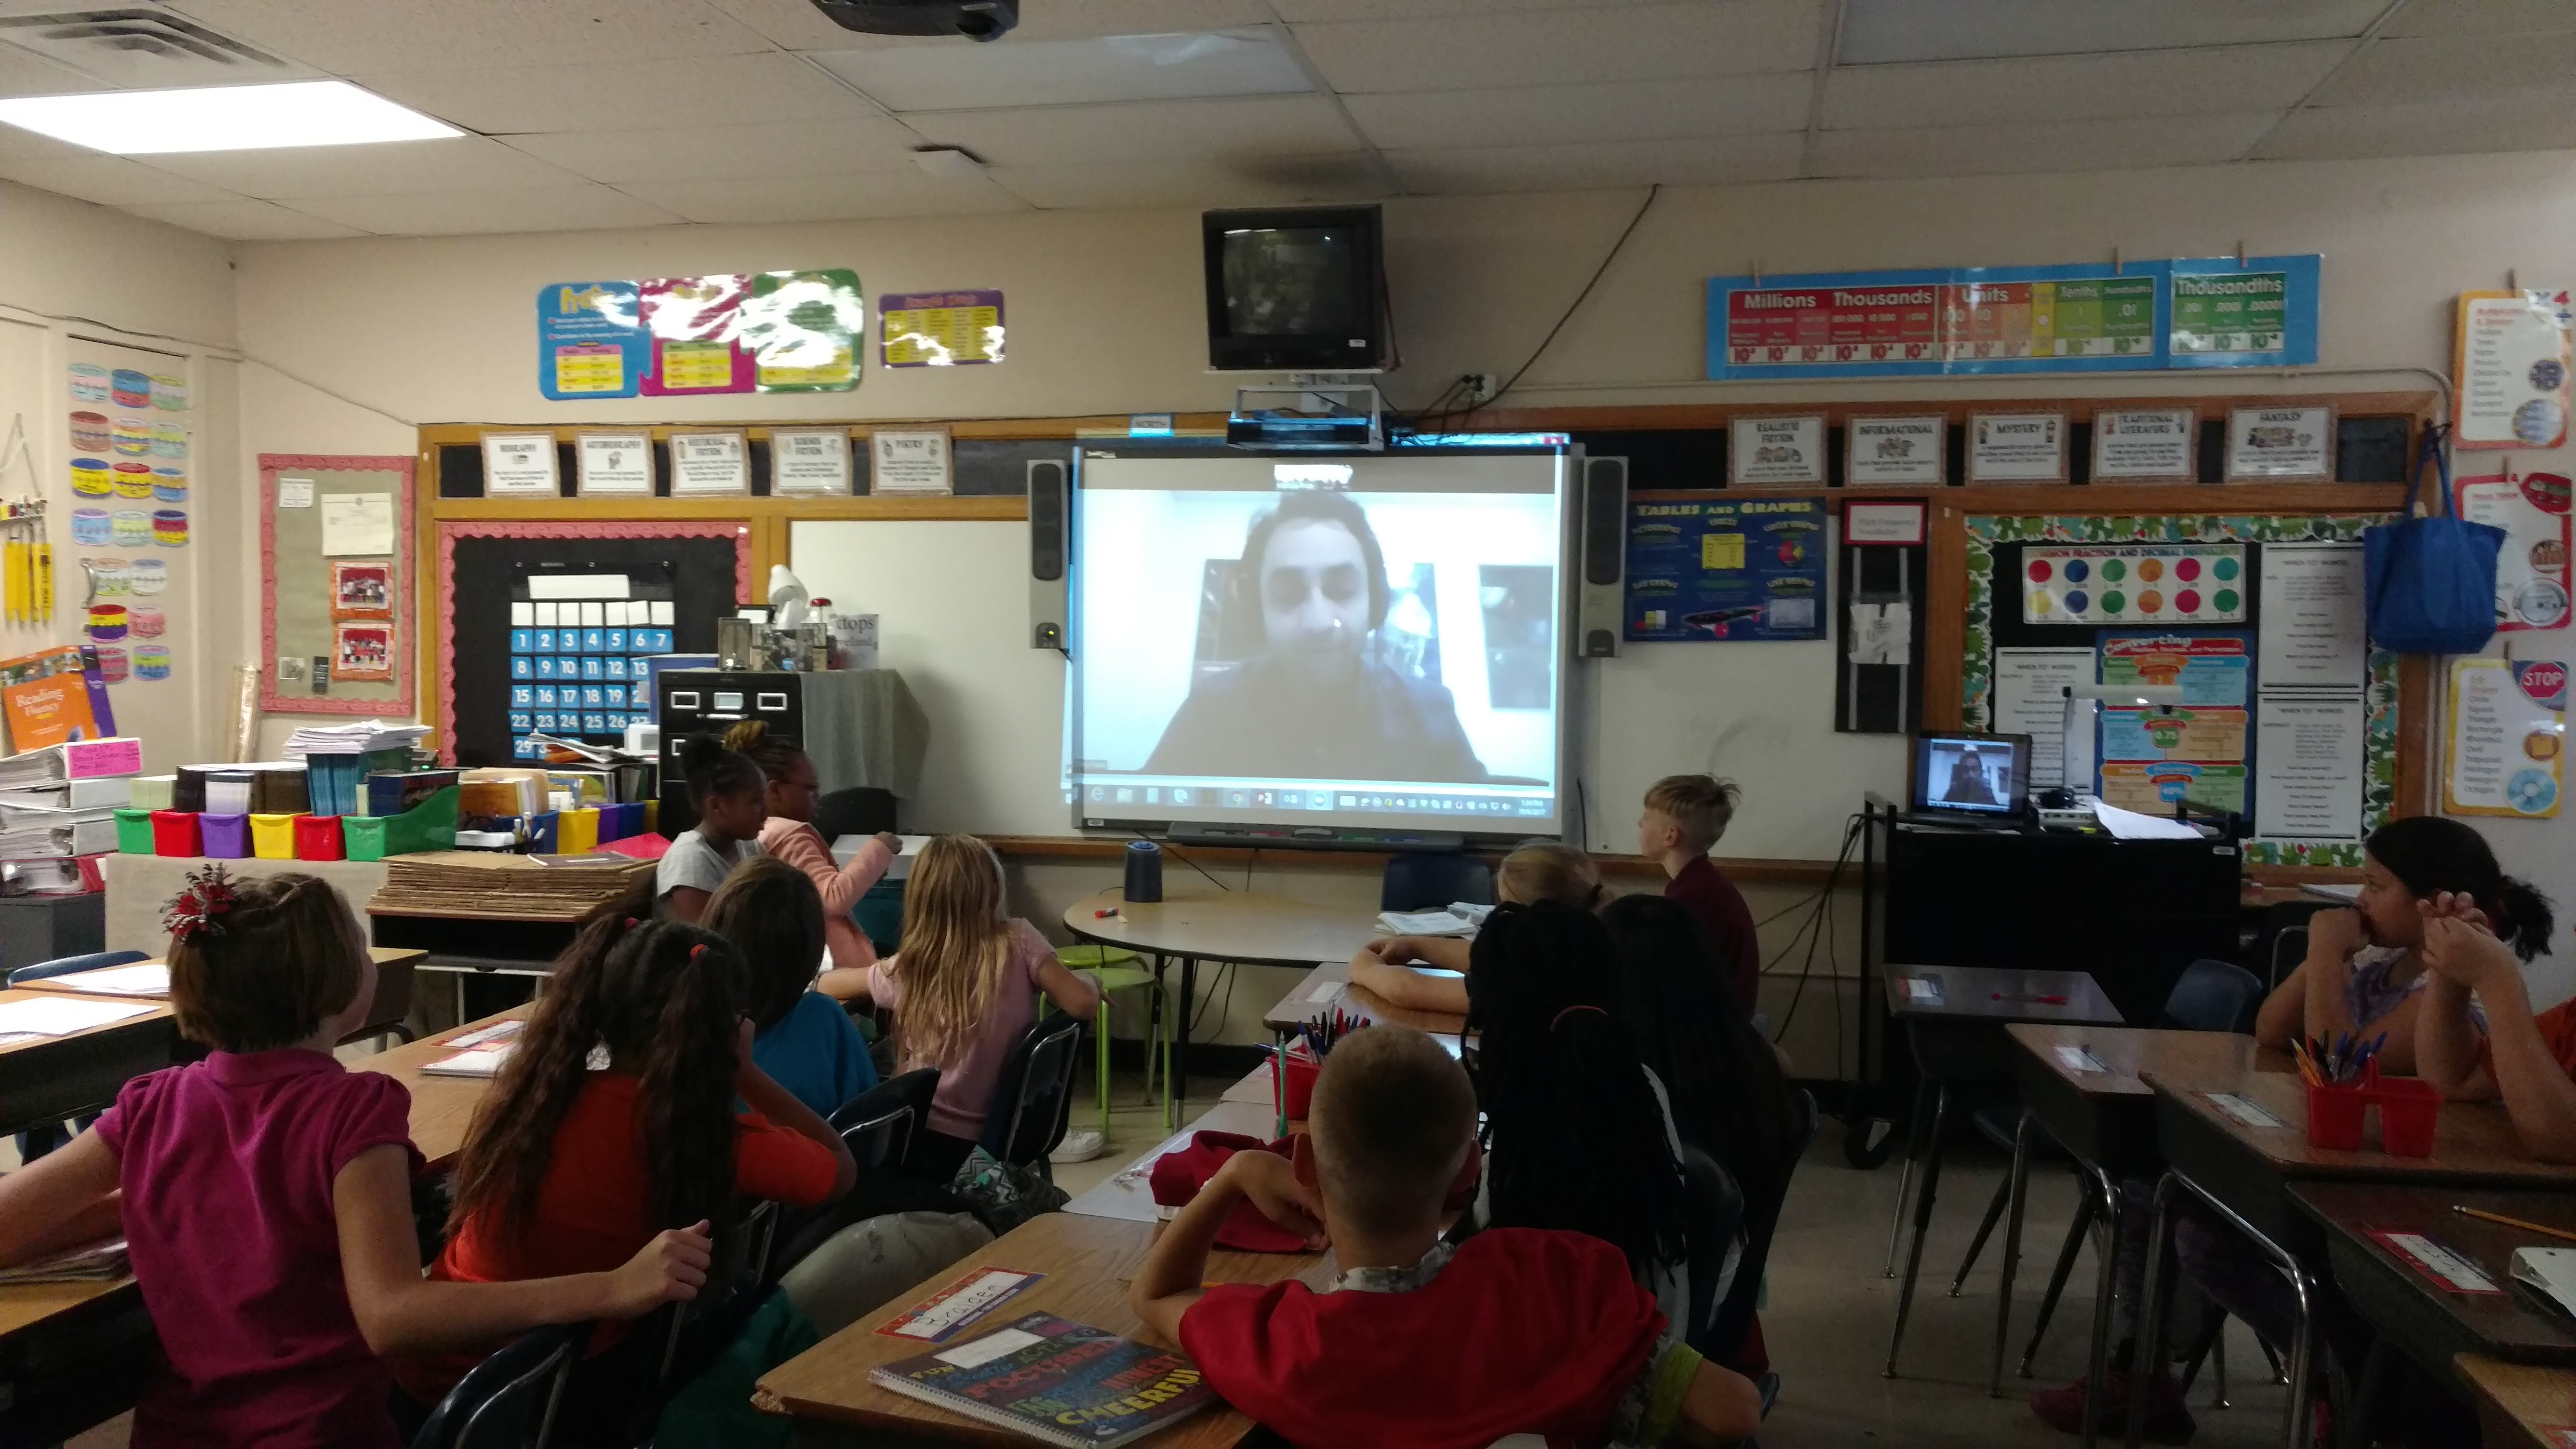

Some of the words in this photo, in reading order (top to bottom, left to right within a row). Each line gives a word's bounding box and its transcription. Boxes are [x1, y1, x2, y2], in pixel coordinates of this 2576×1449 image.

[1744, 293, 1816, 309] Millions
[1833, 289, 1933, 307] Thousands
[1962, 287, 2010, 304] Units
[1636, 504, 1701, 516] TABLES
[520, 634, 526, 646] 1
[540, 634, 550, 646] 2
[565, 634, 574, 646] 3
[588, 633, 598, 646] 4
[611, 633, 621, 646] 5
[636, 634, 645, 646] 6
[657, 634, 666, 646] 7
[2102, 634, 2192, 656] Converting
[518, 660, 527, 673] 8
[542, 660, 551, 673] 9
[561, 661, 575, 674] 10
[587, 661, 598, 674] 11
[609, 661, 623, 674] 12
[633, 662, 648, 674] 13
[2524, 672, 2563, 687] STOP
[15, 689, 65, 707] Reading
[515, 690, 529, 702] 15
[540, 690, 553, 702] 16
[563, 690, 577, 702] 17
[585, 690, 599, 702] 18
[609, 690, 622, 702] 19
[511, 715, 529, 727] 22
[537, 715, 554, 727] 23
[560, 715, 578, 727] 24
[585, 716, 602, 727] 25
[608, 715, 625, 727] 26
[516, 740, 530, 752] 29
[910, 1365, 956, 1379] FUN
